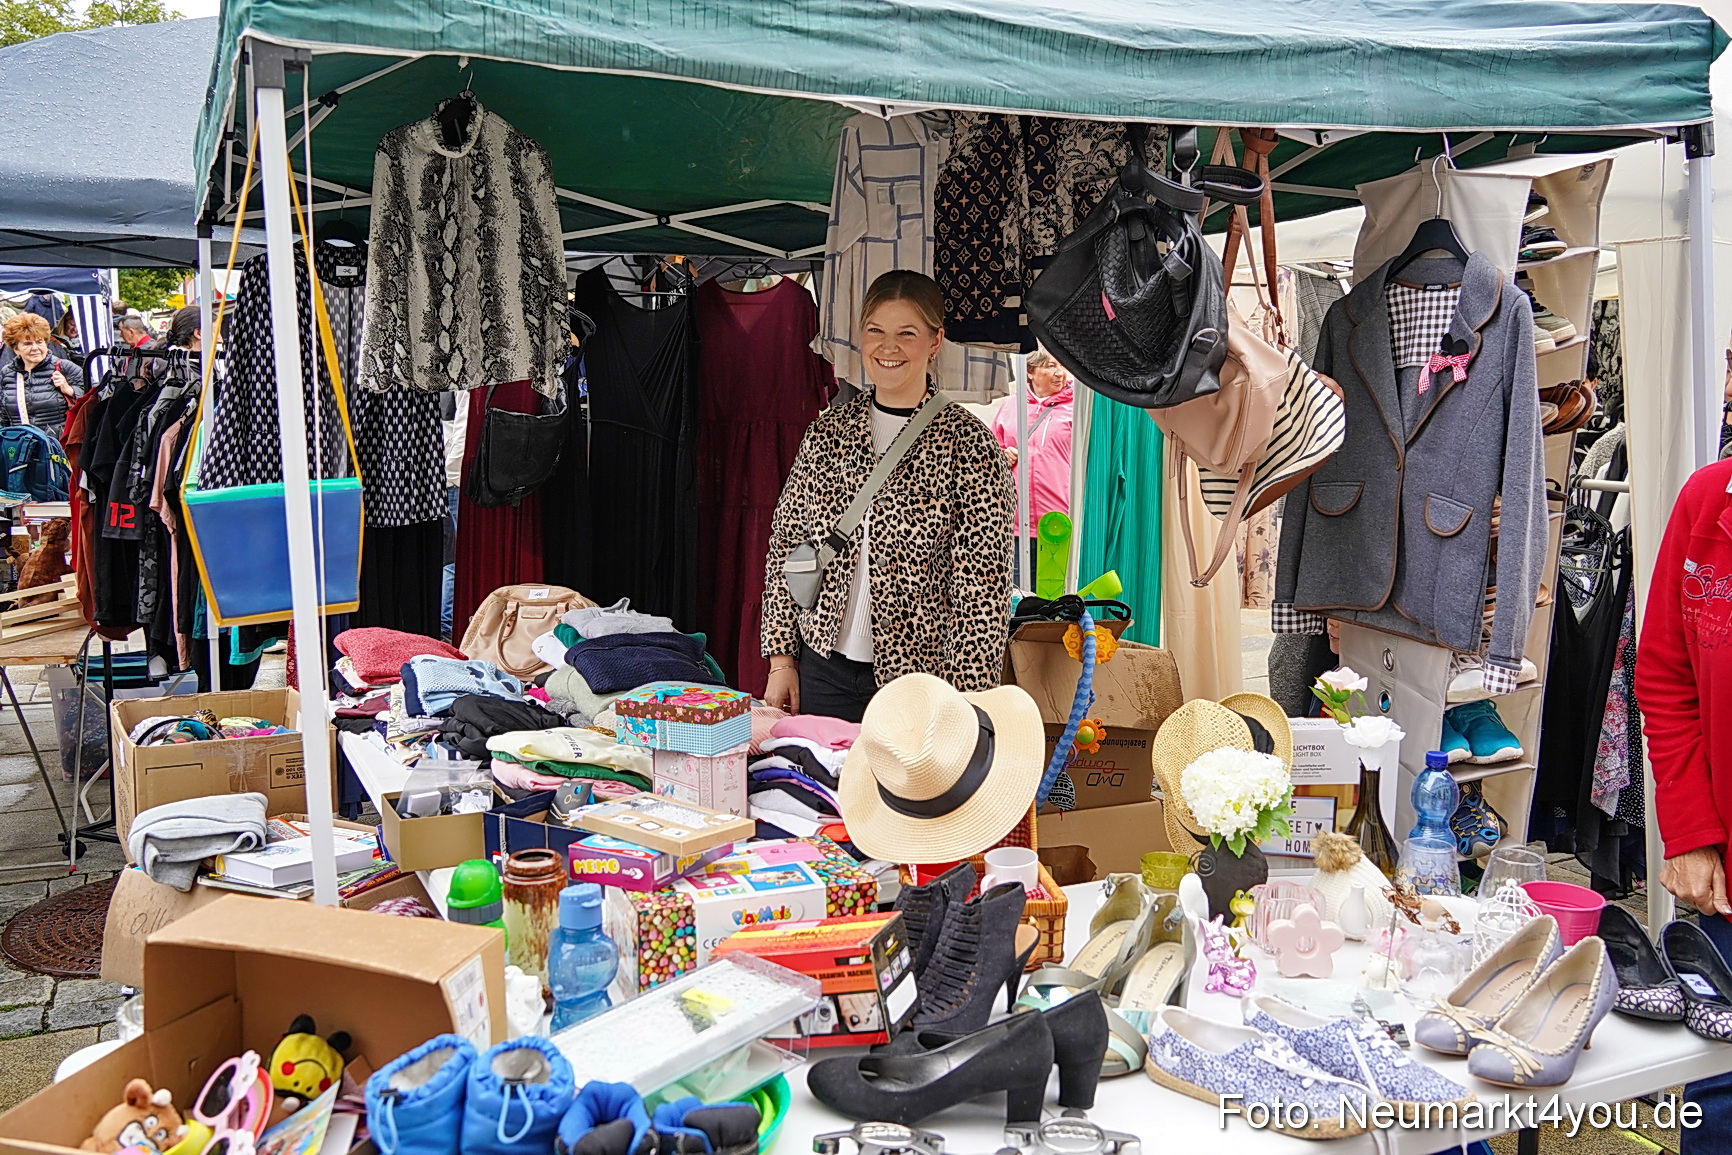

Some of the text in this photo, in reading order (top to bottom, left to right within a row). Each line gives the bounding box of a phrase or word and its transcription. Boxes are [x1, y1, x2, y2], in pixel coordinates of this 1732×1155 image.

[109, 501, 136, 529] 12
[1068, 758, 1116, 774] Compa
[1285, 838, 1311, 854] HOM
[573, 857, 620, 874] MEMO
[731, 904, 792, 925] PlayMais
[1091, 930, 1127, 959] Tamaris
[818, 972, 846, 980] DRAWING
[847, 969, 872, 977] MACHINE
[1146, 954, 1173, 988] Tamaris
[1499, 970, 1531, 992] Tamaris
[1562, 994, 1588, 1023] Tamaris
